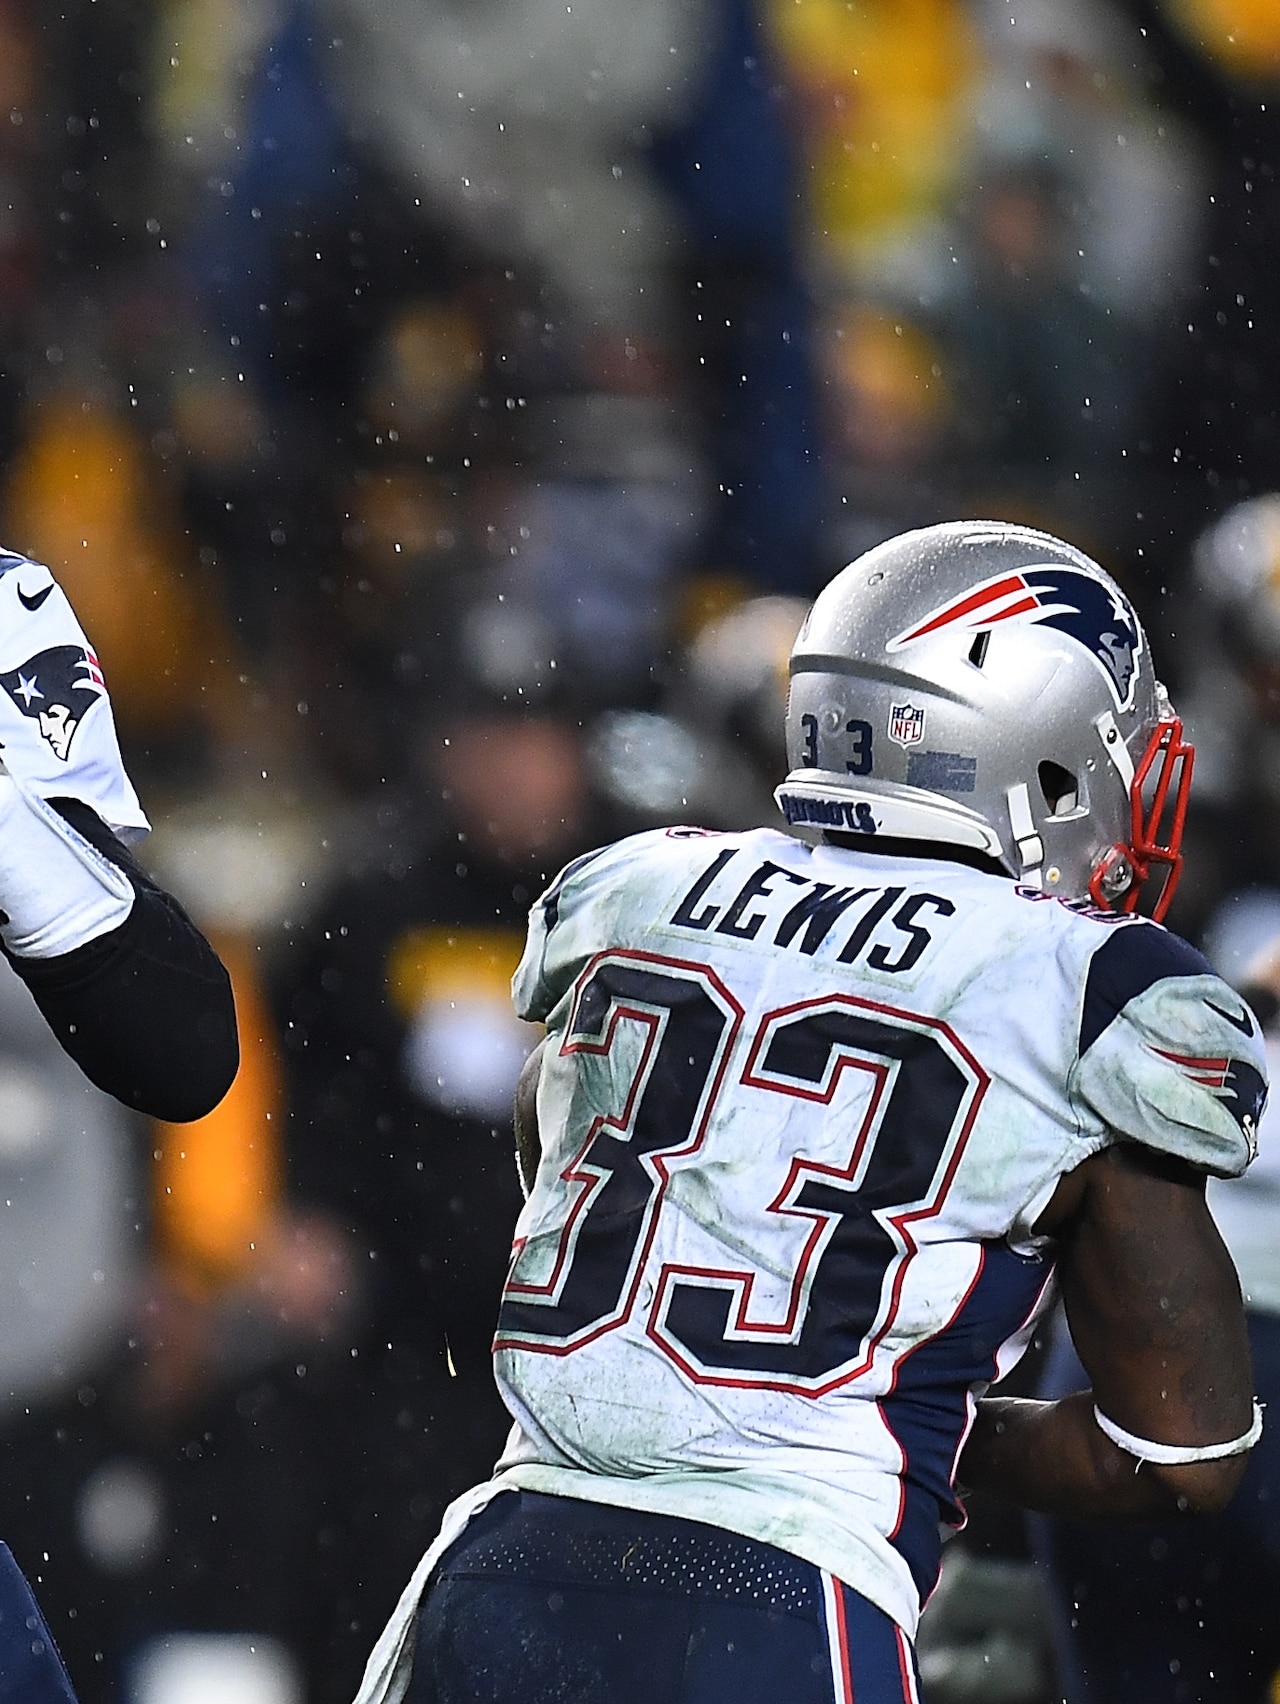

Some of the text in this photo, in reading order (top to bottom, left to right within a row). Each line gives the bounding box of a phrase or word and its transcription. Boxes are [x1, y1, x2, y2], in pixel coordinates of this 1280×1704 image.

[893, 719, 920, 740] NFL
[669, 848, 957, 974] LEWIS
[493, 948, 992, 1400] 33
